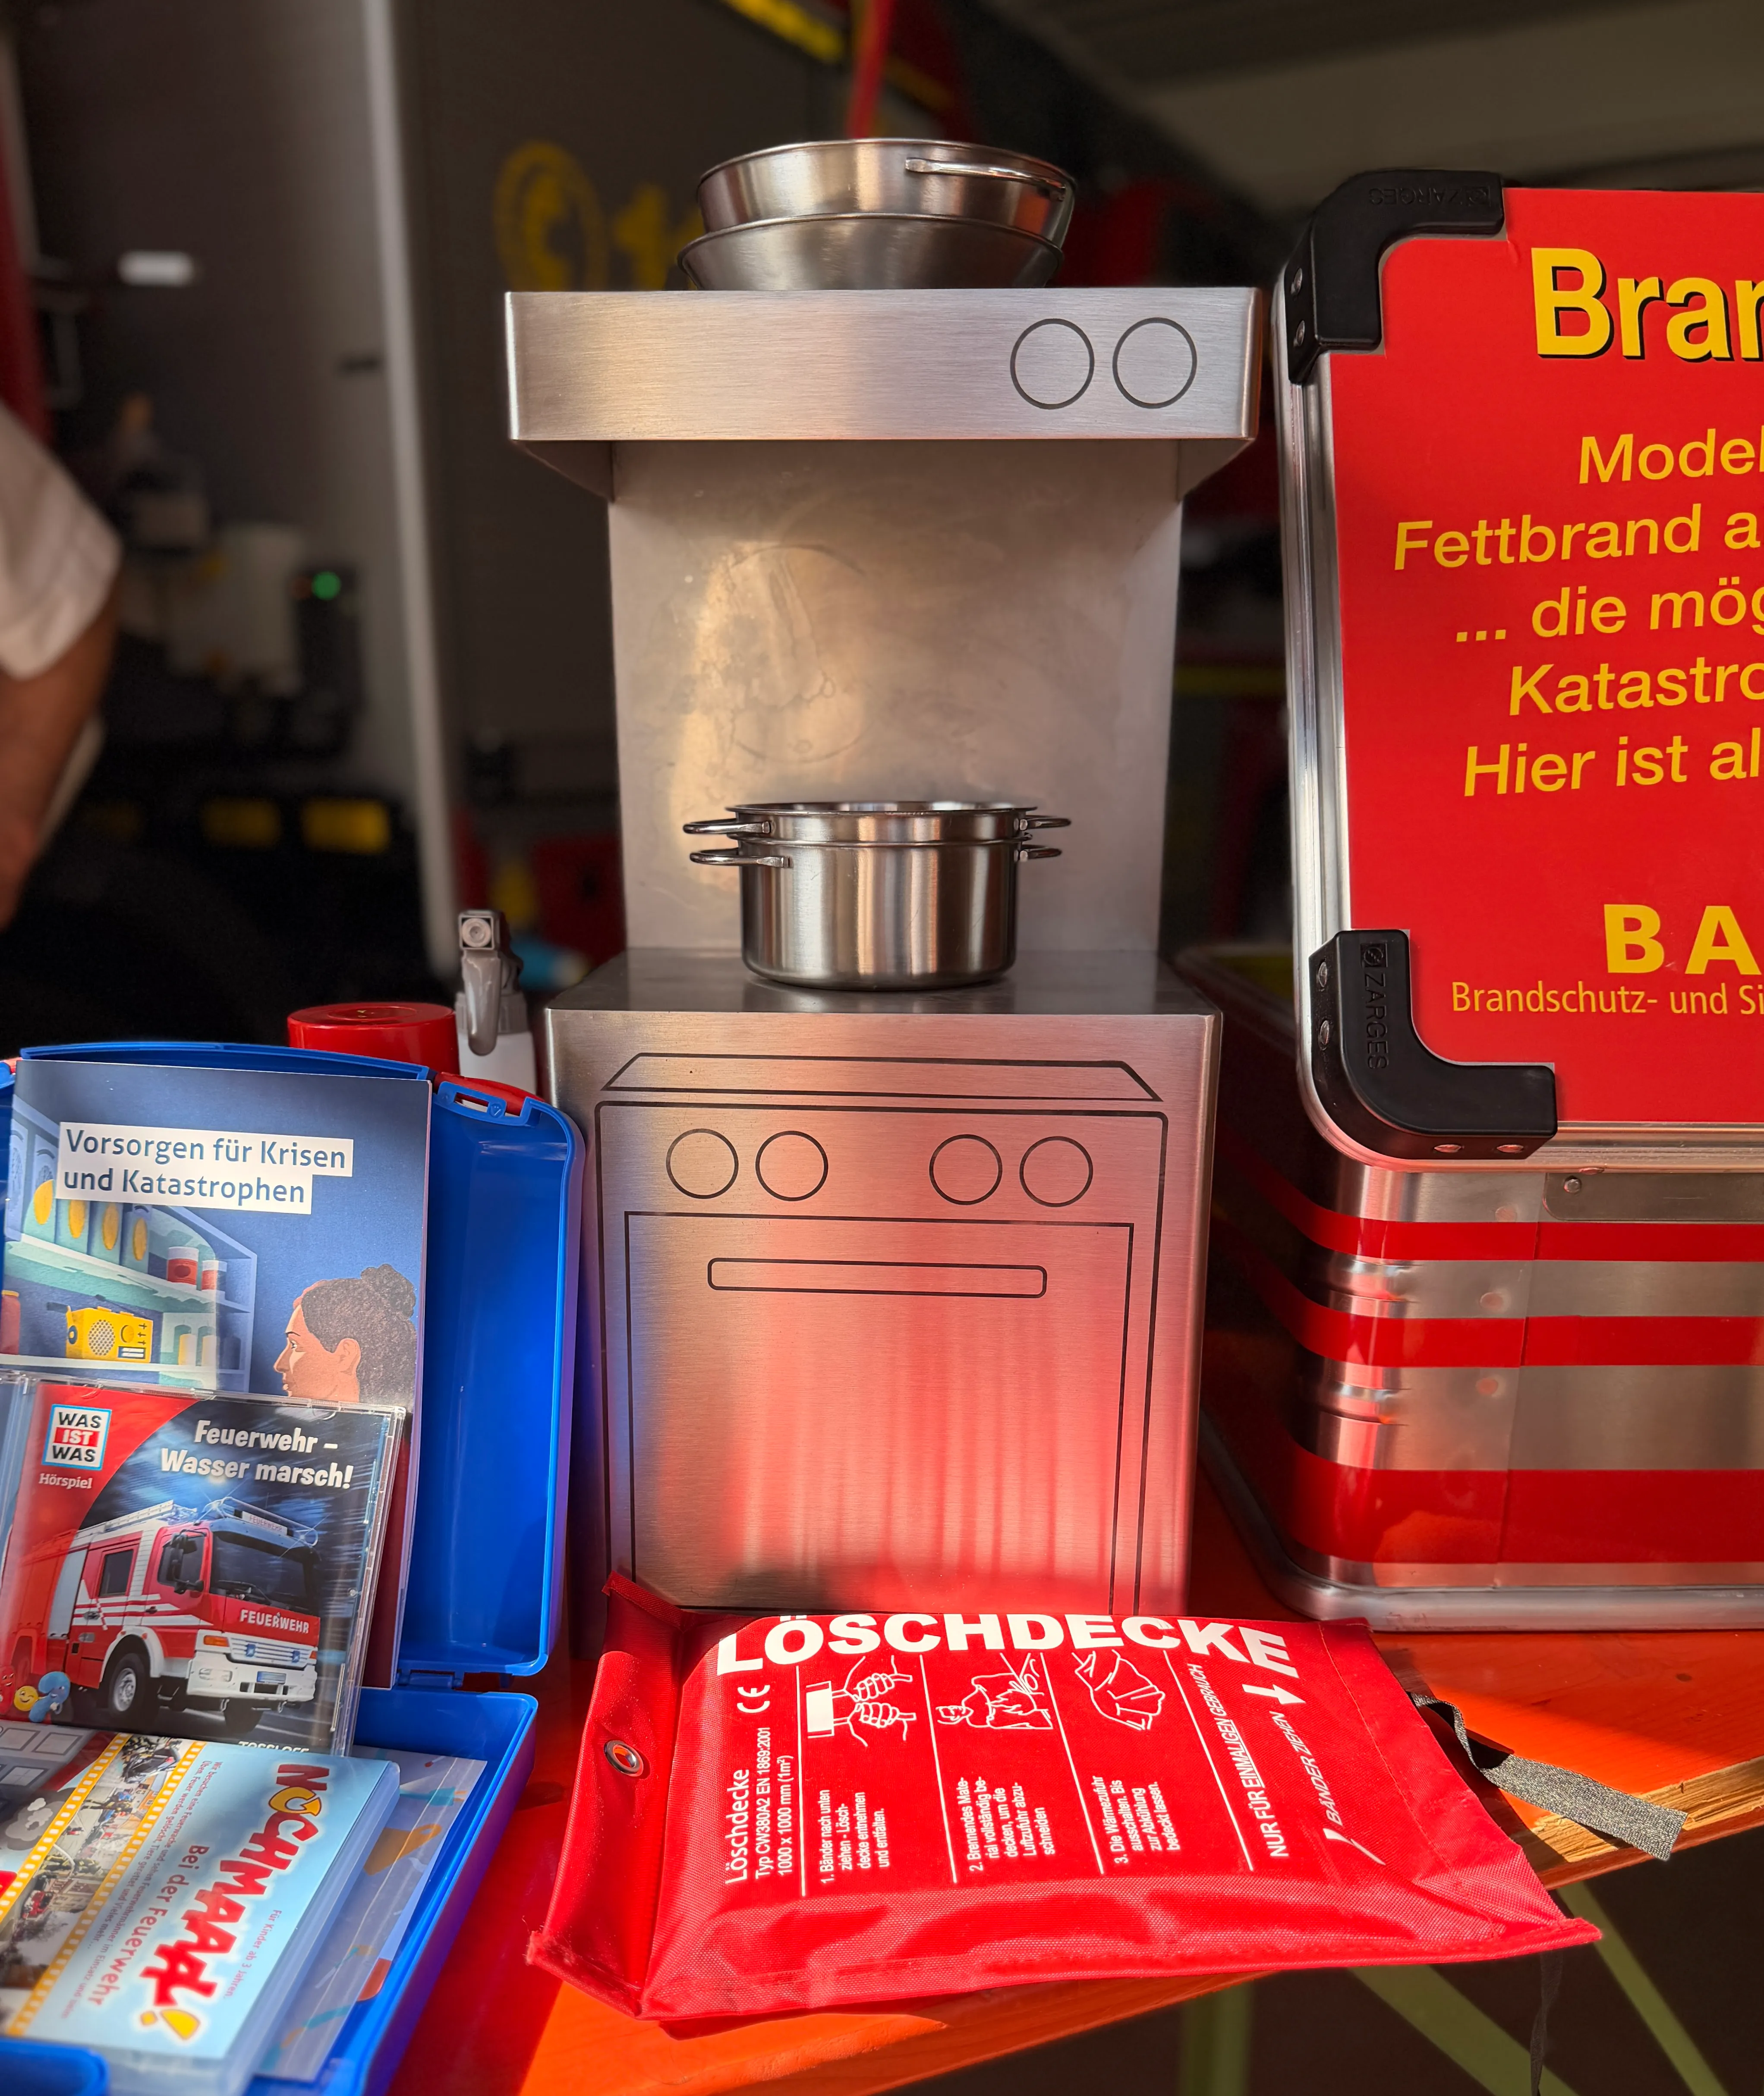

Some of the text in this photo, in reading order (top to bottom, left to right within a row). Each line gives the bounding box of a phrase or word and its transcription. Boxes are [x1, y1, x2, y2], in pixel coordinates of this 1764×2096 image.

[1395, 504, 1761, 570] Fettbrand a
[1456, 629, 1506, 642] ...
[1532, 586, 1626, 637] die
[1509, 657, 1764, 716] Katastro
[1465, 727, 1761, 796] Hier ist al
[1452, 980, 1764, 1015] Brandschutz- und Si
[1365, 972, 1389, 1069] ZARGES
[66, 1129, 345, 1168] Vorsorgen für Krisen
[64, 1168, 304, 1206] und Katastrophen
[59, 1412, 102, 1429] WAS
[62, 1429, 93, 1445] IST
[194, 1420, 318, 1453] Feuerwehr
[52, 1445, 96, 1462] WAS
[161, 1448, 354, 1489] Wasser marsch!
[39, 1473, 93, 1489] Hörspiel
[249, 1515, 283, 1533] FEUERWEHR
[240, 1609, 309, 1633] FEUERWEHR
[717, 1613, 1299, 1678] LÖSCHDECKE
[211, 1761, 223, 1770] Wir
[1187, 1663, 1289, 1857] NUR FÜR EINMALIGEN GEBRAUCH
[1269, 1711, 1343, 1826] BÄNDER ZIEHEN
[185, 1776, 200, 1791] Feuer
[195, 1771, 217, 1797] besuchen
[780, 1784, 791, 1804] mm
[172, 1793, 189, 1814] werden
[186, 1798, 199, 1810] eine
[756, 1727, 774, 1879] Typ CW380A2 EN 1869:2001
[835, 1803, 850, 1833] Lösch-
[974, 1776, 999, 1858] rial vollständig be-
[1011, 1782, 1037, 1856] Luftzufuhr abzu-
[1091, 1775, 1128, 1864] 3. Die Wärmezufuhr
[1109, 1780, 1143, 1851] ausschalten. Bis
[1131, 1788, 1162, 1851] zur Abkühlung
[1148, 1781, 1181, 1851] bedeckt lassen.
[164, 1812, 192, 1848] Feuerwache
[725, 1769, 749, 1884] Löschdecke
[777, 1807, 792, 1835] 1000
[818, 1789, 835, 1884] 1. Bänder nach unten
[853, 1792, 871, 1869] decke entnehmen
[872, 1808, 890, 1867] und entfalten.
[956, 1777, 983, 1871] 2. Brennendes Mate-
[992, 1788, 1018, 1857] decken, um die
[1033, 1807, 1055, 1855] schneiden
[144, 1844, 160, 1860] Tiere
[156, 1849, 169, 1862] und
[778, 1847, 792, 1876] 1000
[838, 1840, 852, 1870] ziehen
[126, 1861, 147, 1887] gerettet
[143, 1862, 160, 1881] sehen
[107, 1881, 149, 1942] Feuerwehrmänner
[117, 1888, 130, 1901] und
[88, 1845, 210, 2005] Bei der Feuerwehr
[104, 1902, 124, 1922] Vieles
[268, 1910, 282, 1921] Für
[100, 1943, 113, 1953] im
[253, 1923, 274, 1948] Kinder
[84, 1955, 105, 1980] Einsatz
[246, 1951, 257, 1961] ab
[73, 1983, 87, 1997] und
